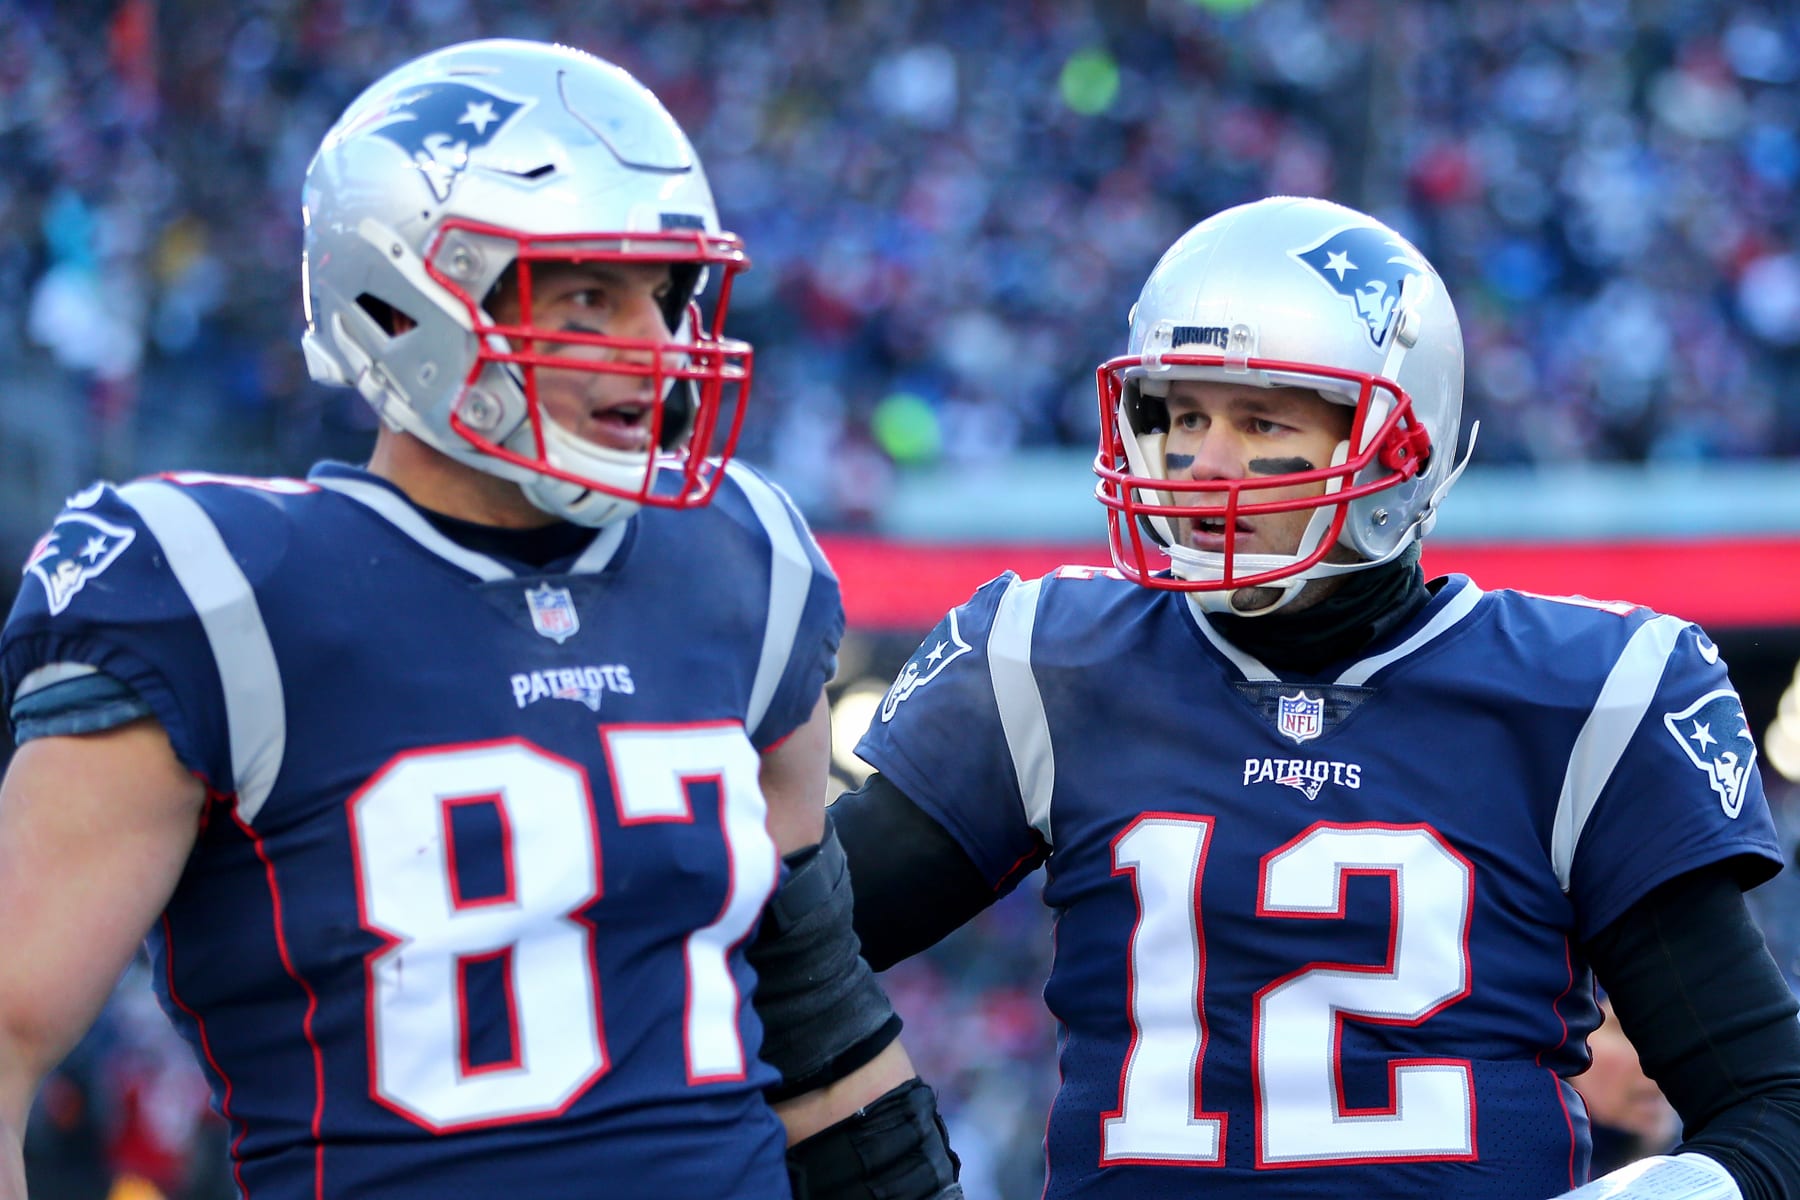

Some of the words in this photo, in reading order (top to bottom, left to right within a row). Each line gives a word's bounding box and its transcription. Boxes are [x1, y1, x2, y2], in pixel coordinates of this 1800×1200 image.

[1172, 326, 1228, 349] PATRIOTS
[511, 664, 635, 708] PATRIOTS
[1284, 713, 1315, 733] NFL
[1243, 758, 1362, 789] PATRIOTS
[346, 719, 779, 1135] 87
[1100, 811, 1479, 1170] 12
